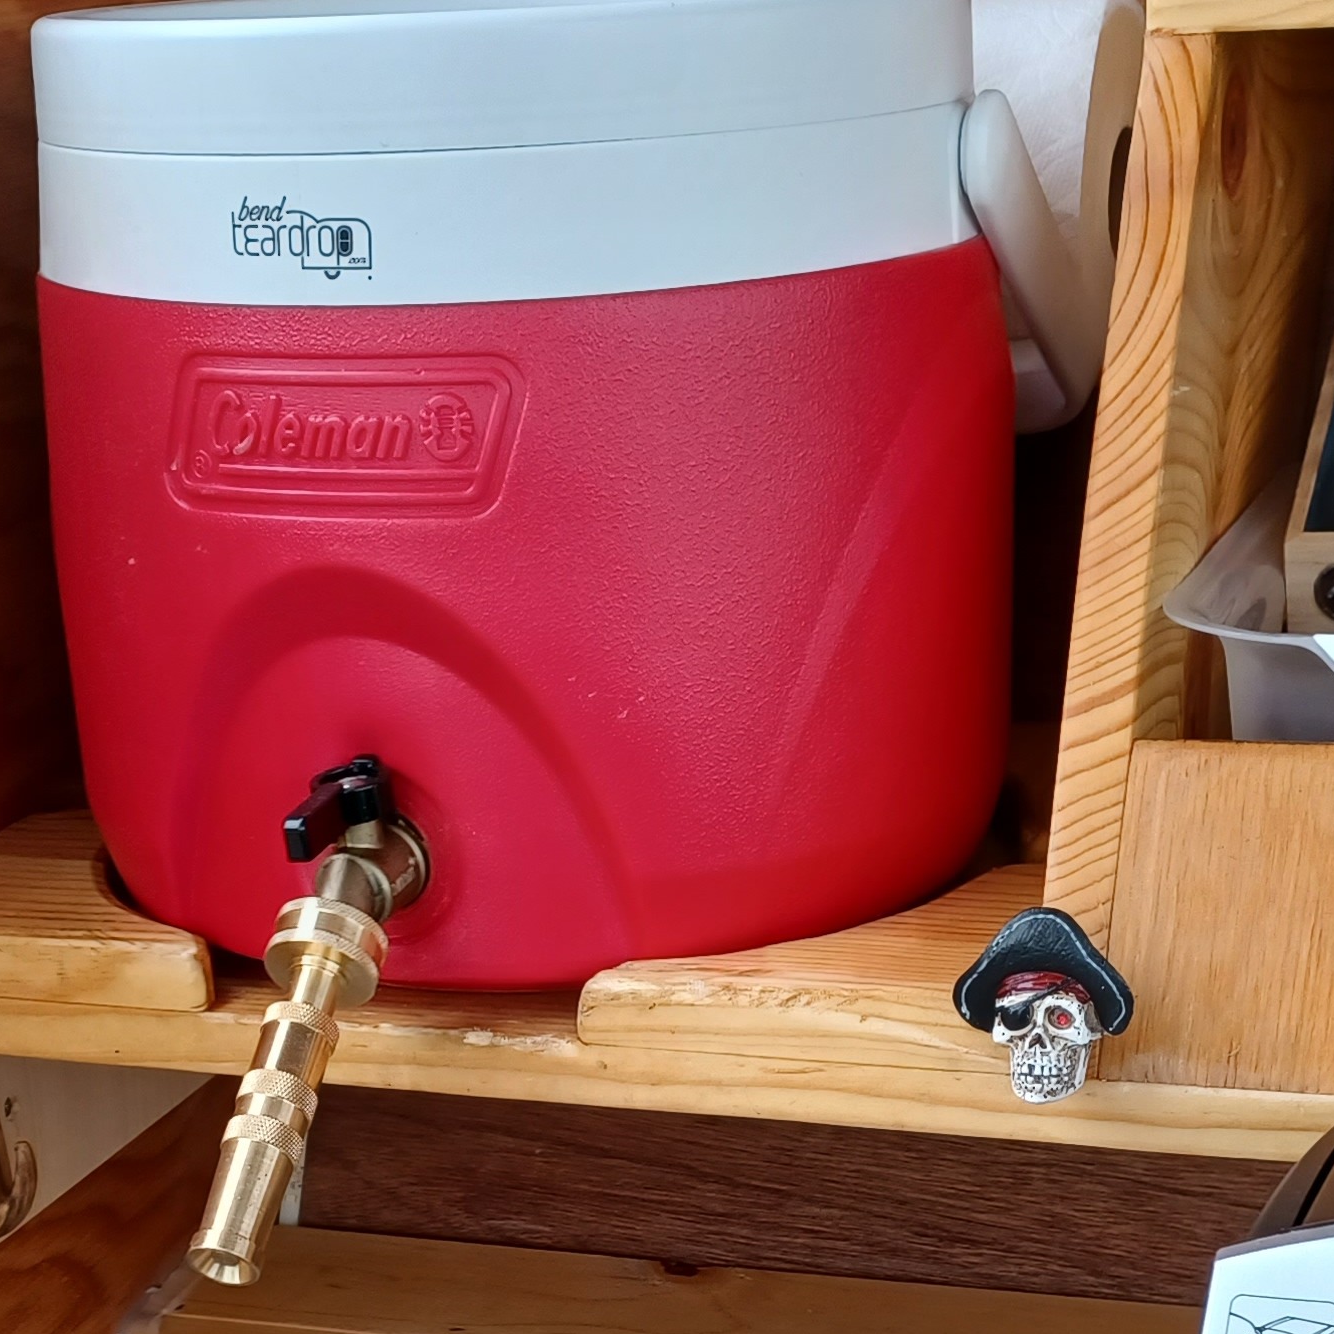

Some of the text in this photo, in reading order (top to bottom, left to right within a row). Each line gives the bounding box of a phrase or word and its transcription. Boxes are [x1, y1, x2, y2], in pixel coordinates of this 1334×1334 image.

[238, 196, 287, 222] bend
[231, 211, 354, 266] teardrop
[213, 390, 413, 459] Coleman
